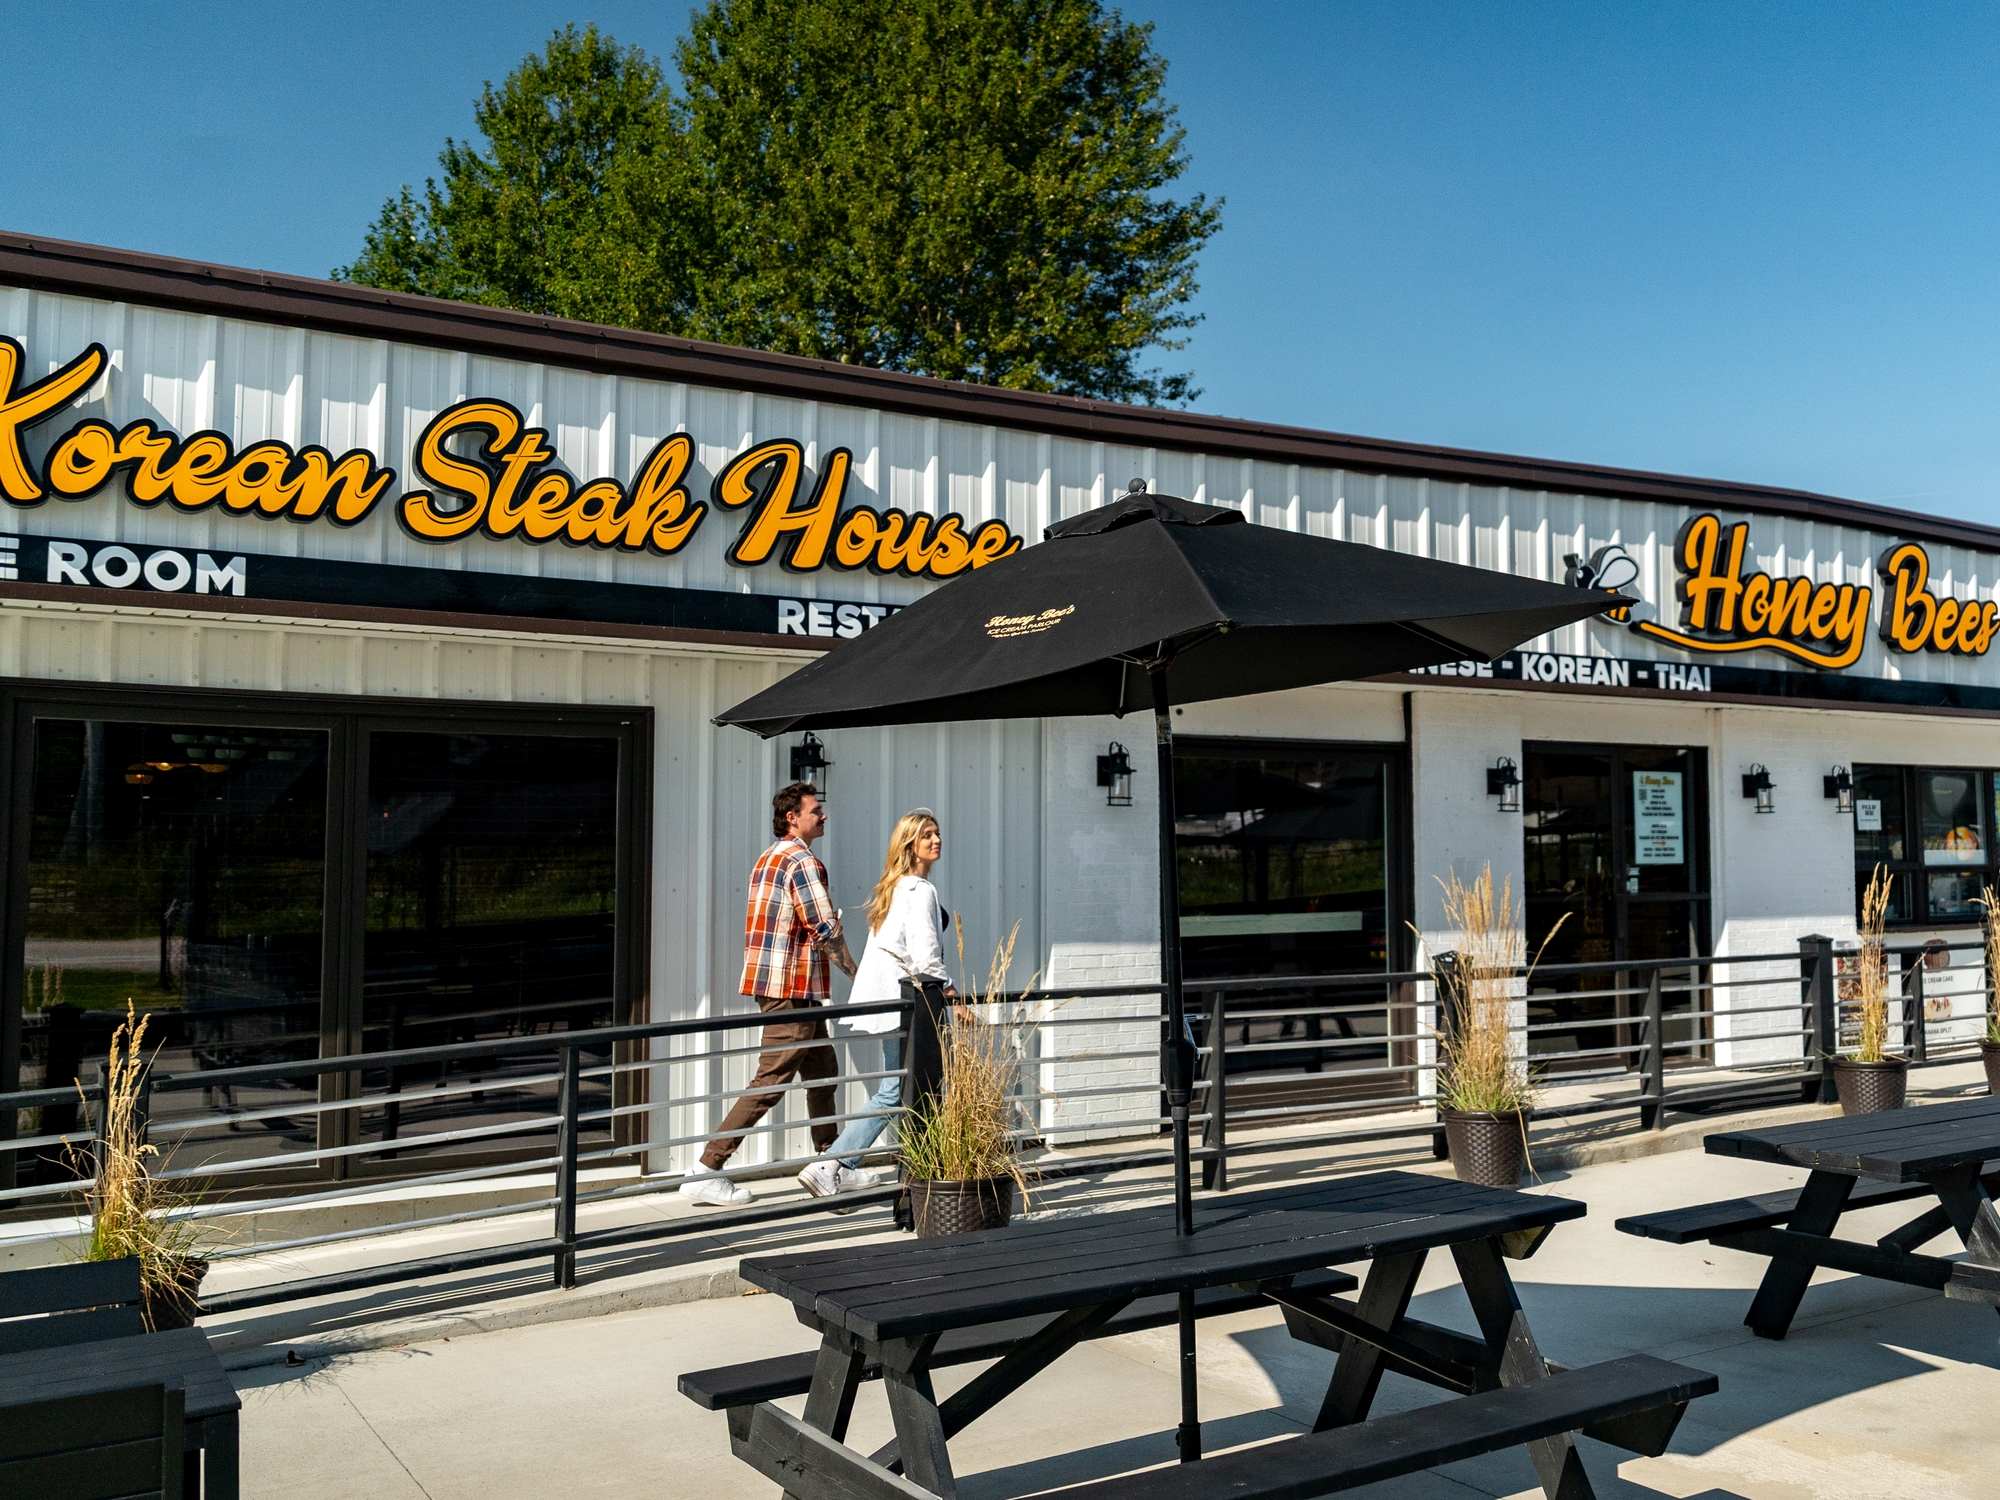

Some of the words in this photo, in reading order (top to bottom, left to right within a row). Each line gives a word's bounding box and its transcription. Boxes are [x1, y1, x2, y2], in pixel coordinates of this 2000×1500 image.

[0, 337, 393, 523] Korean
[401, 400, 706, 553] Steak
[718, 440, 1021, 578] House
[47, 541, 247, 597] ROOM
[1640, 514, 1873, 670] Honey
[1888, 543, 2000, 654] Bees
[778, 599, 902, 639] REST
[984, 615, 1036, 627] Honey
[1001, 625, 1027, 634] CREAM
[1521, 653, 1630, 687] KOREAN
[1654, 663, 1712, 692] THAI
